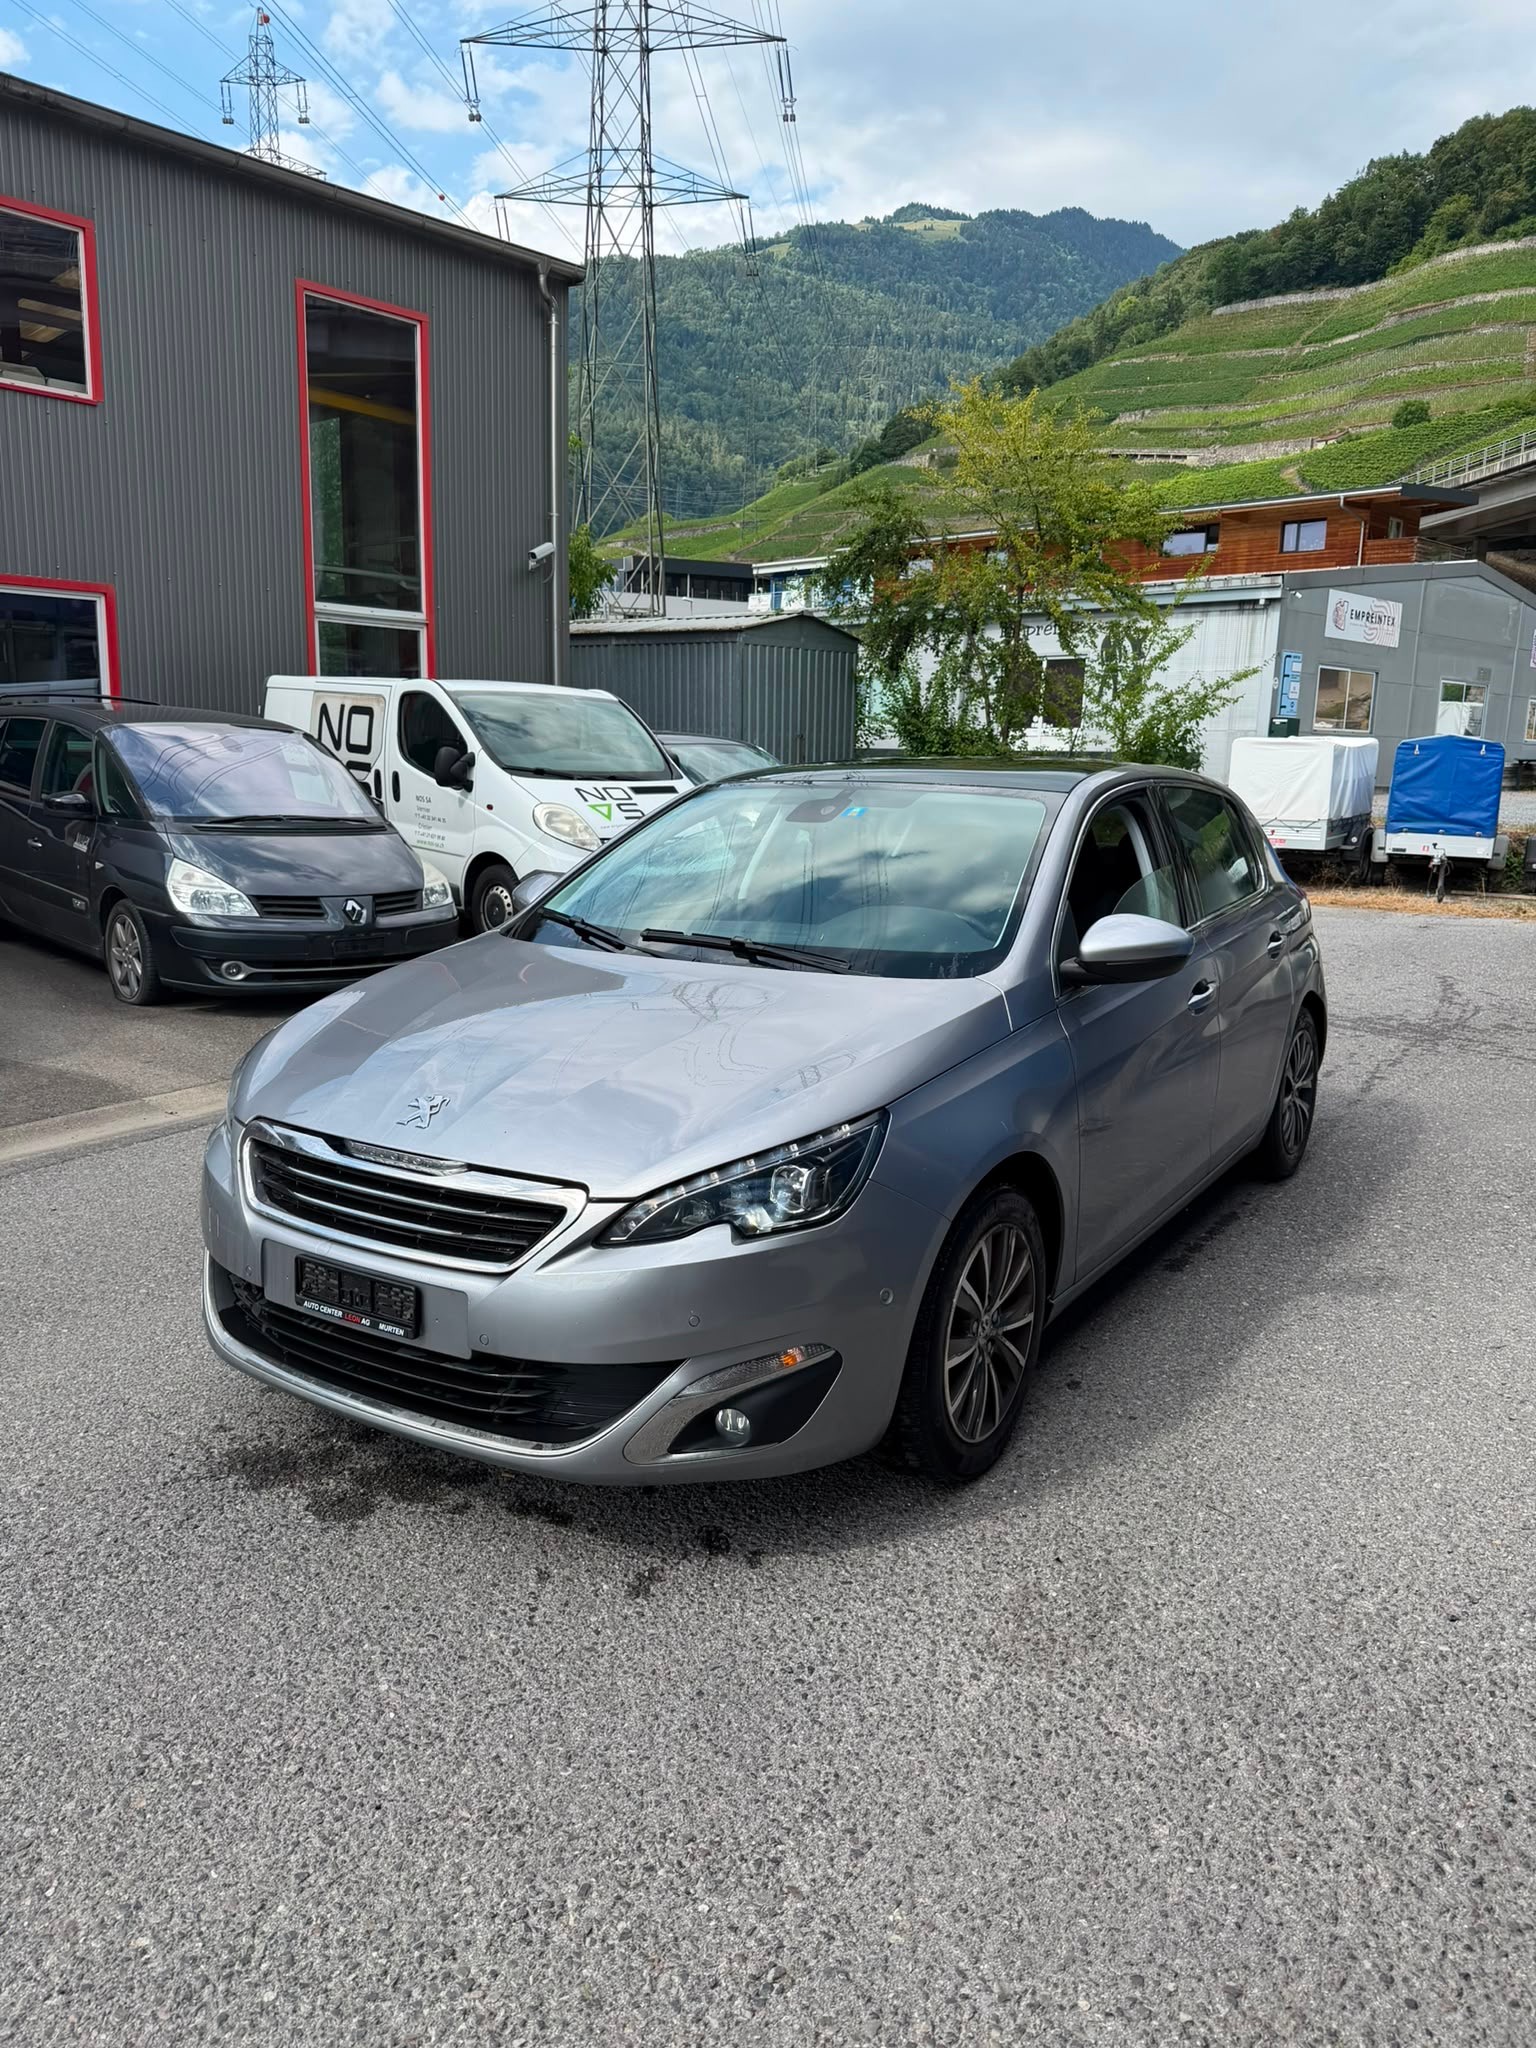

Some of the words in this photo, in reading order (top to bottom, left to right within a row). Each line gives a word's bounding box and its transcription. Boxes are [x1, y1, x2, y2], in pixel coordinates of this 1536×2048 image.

[1350, 609, 1396, 626] EMPREINTEX
[303, 1300, 319, 1311] AUTO
[320, 1305, 343, 1318] CENTER
[344, 1312, 361, 1323] LEON
[361, 1318, 371, 1327] AG
[378, 1322, 405, 1336] MURTEN
